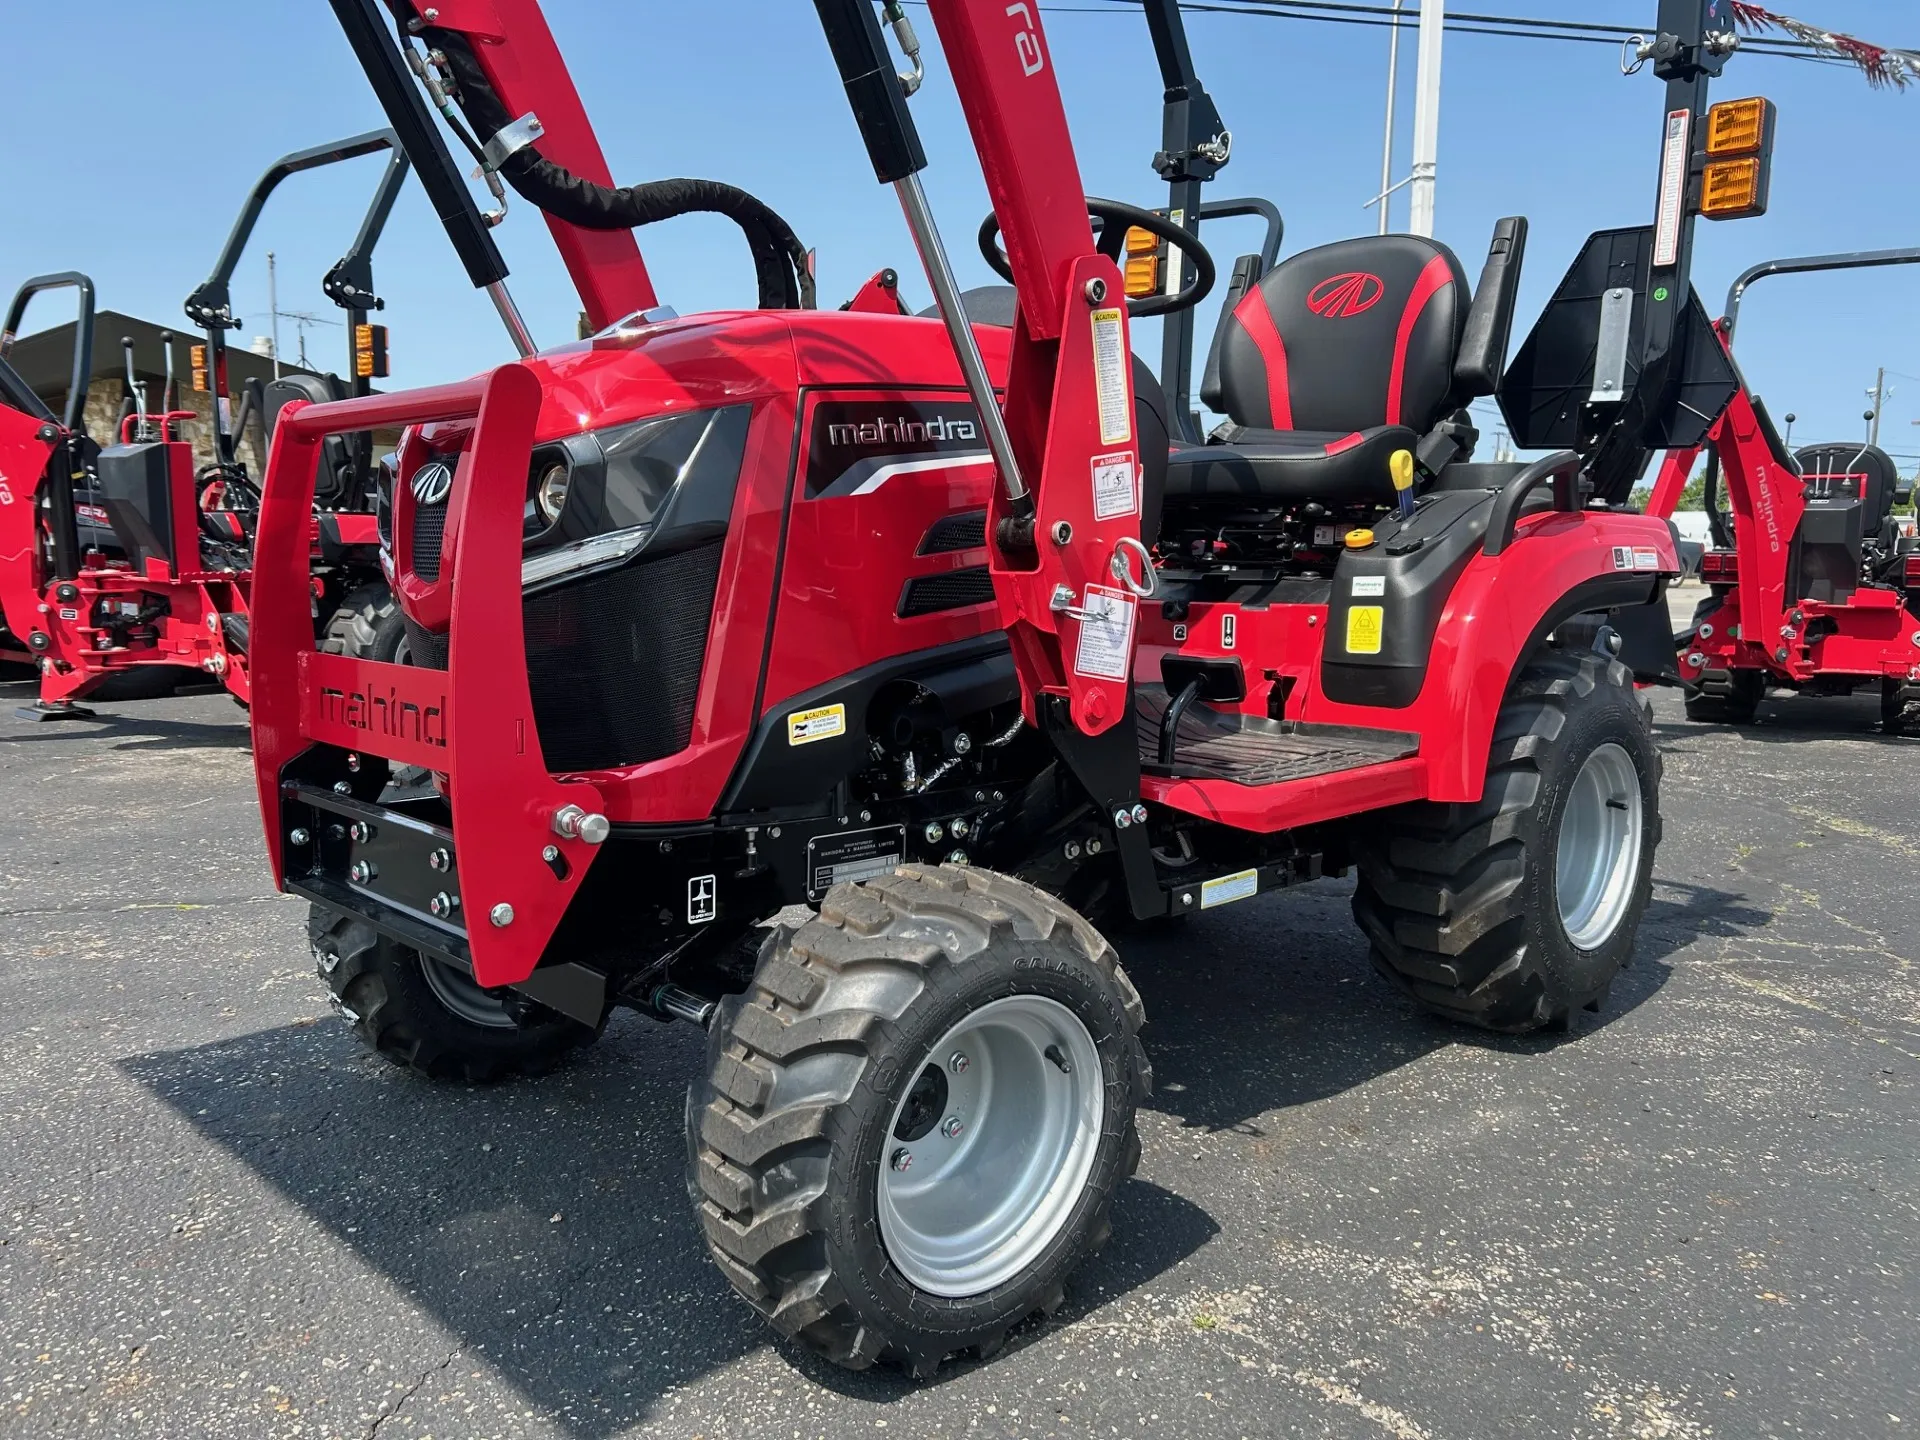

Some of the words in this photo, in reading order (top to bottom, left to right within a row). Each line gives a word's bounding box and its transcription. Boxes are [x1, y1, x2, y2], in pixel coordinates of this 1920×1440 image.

[828, 415, 977, 446] mahindra
[1104, 455, 1127, 465] DANGER
[1756, 465, 1780, 553] mahindra
[1104, 591, 1125, 600] DANGER
[808, 709, 830, 719] CAUTION
[1013, 956, 1095, 988] GALAXY
